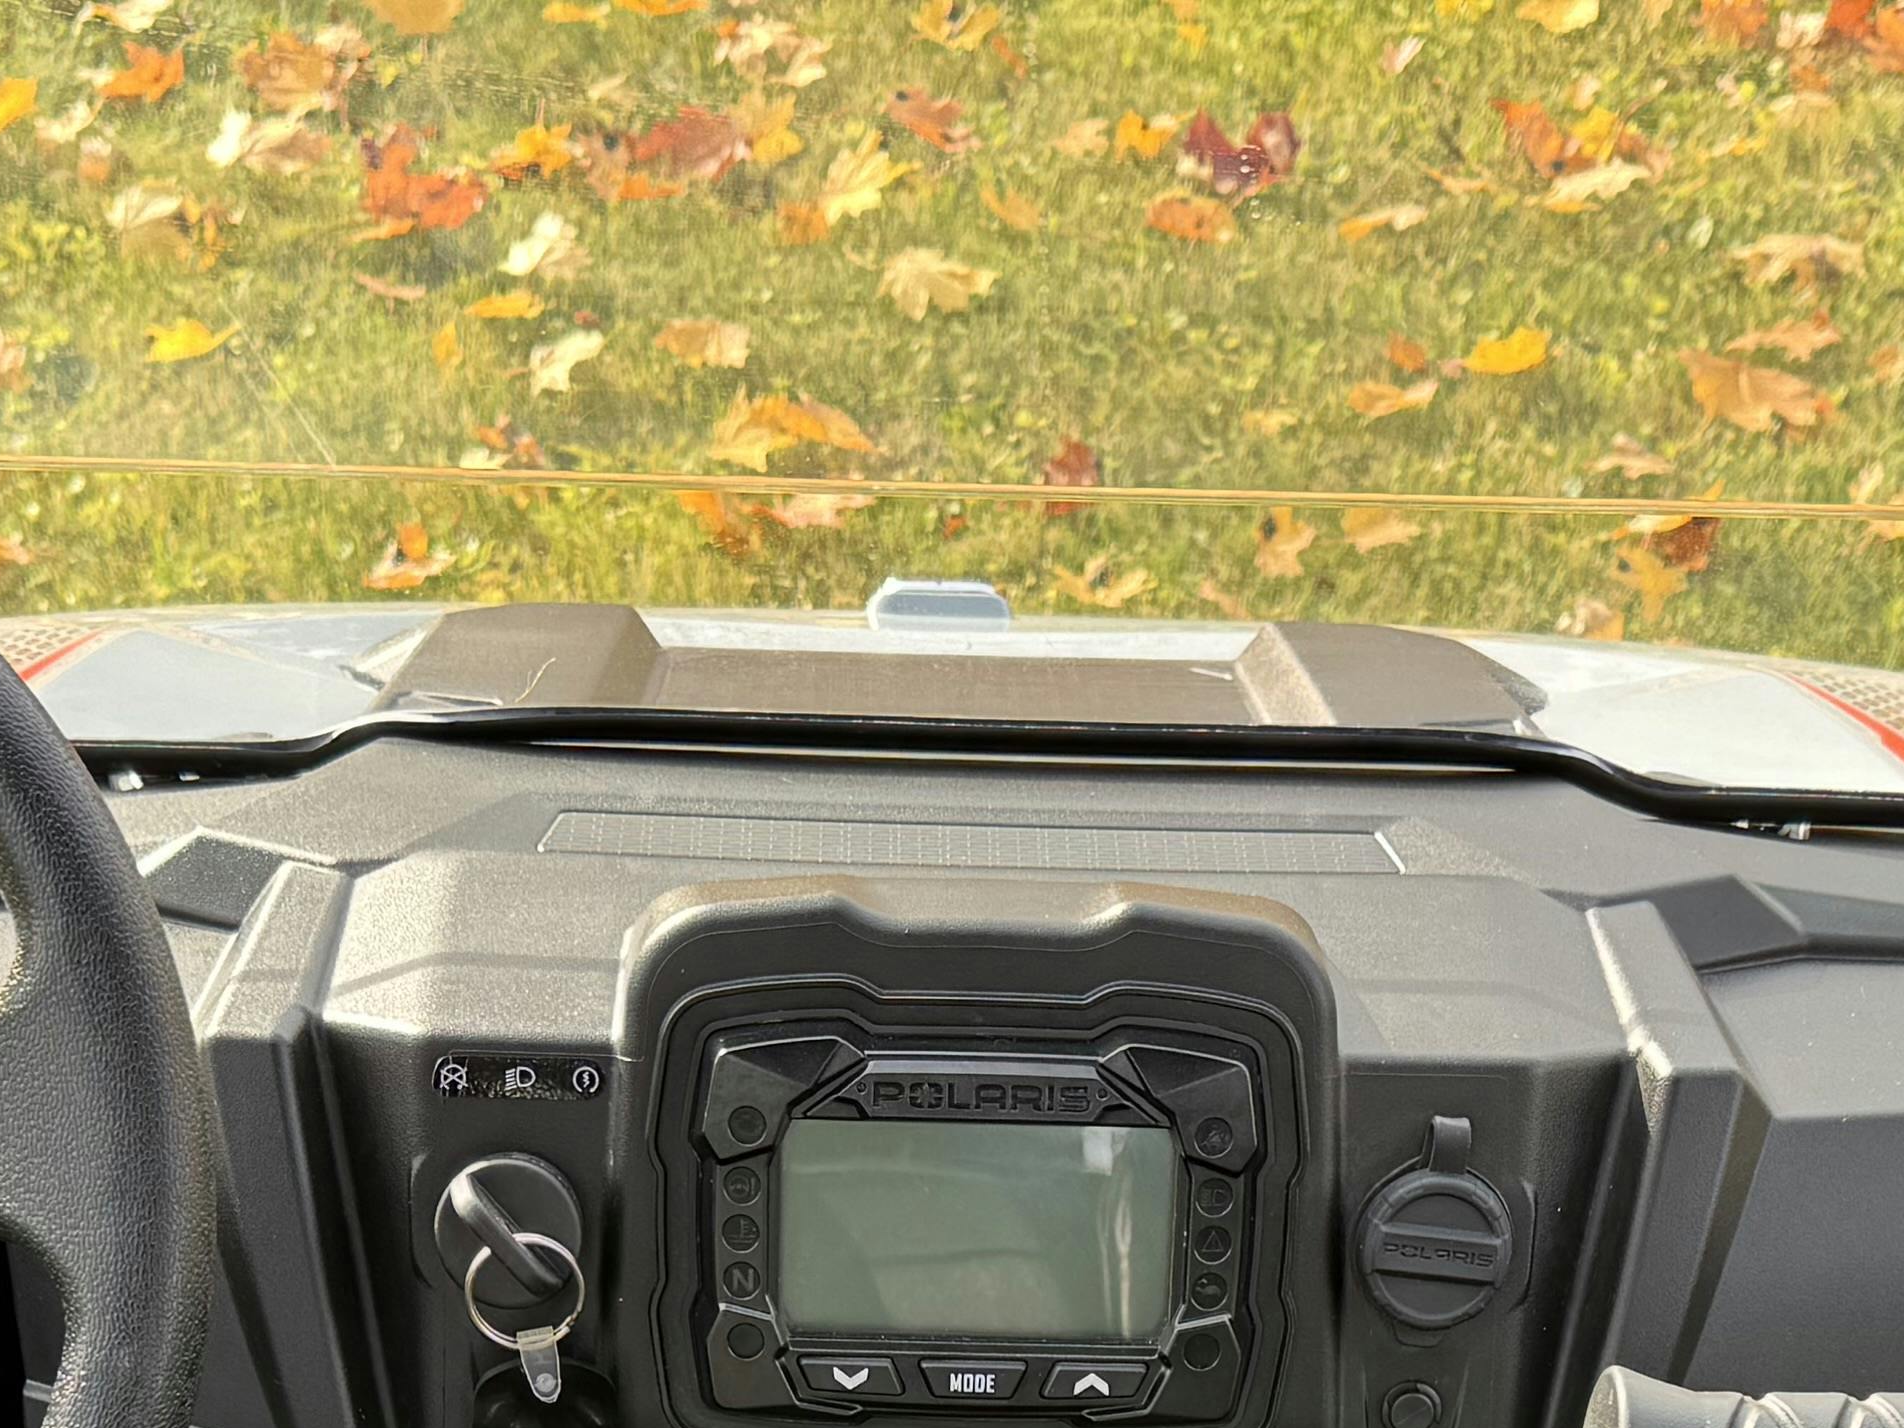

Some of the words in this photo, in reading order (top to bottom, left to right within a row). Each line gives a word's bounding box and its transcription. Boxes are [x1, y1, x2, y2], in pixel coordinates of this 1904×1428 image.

[872, 1081, 1090, 1112] POLARIS
[1383, 1242, 1493, 1268] POLARIS
[949, 1372, 996, 1393] MODE
